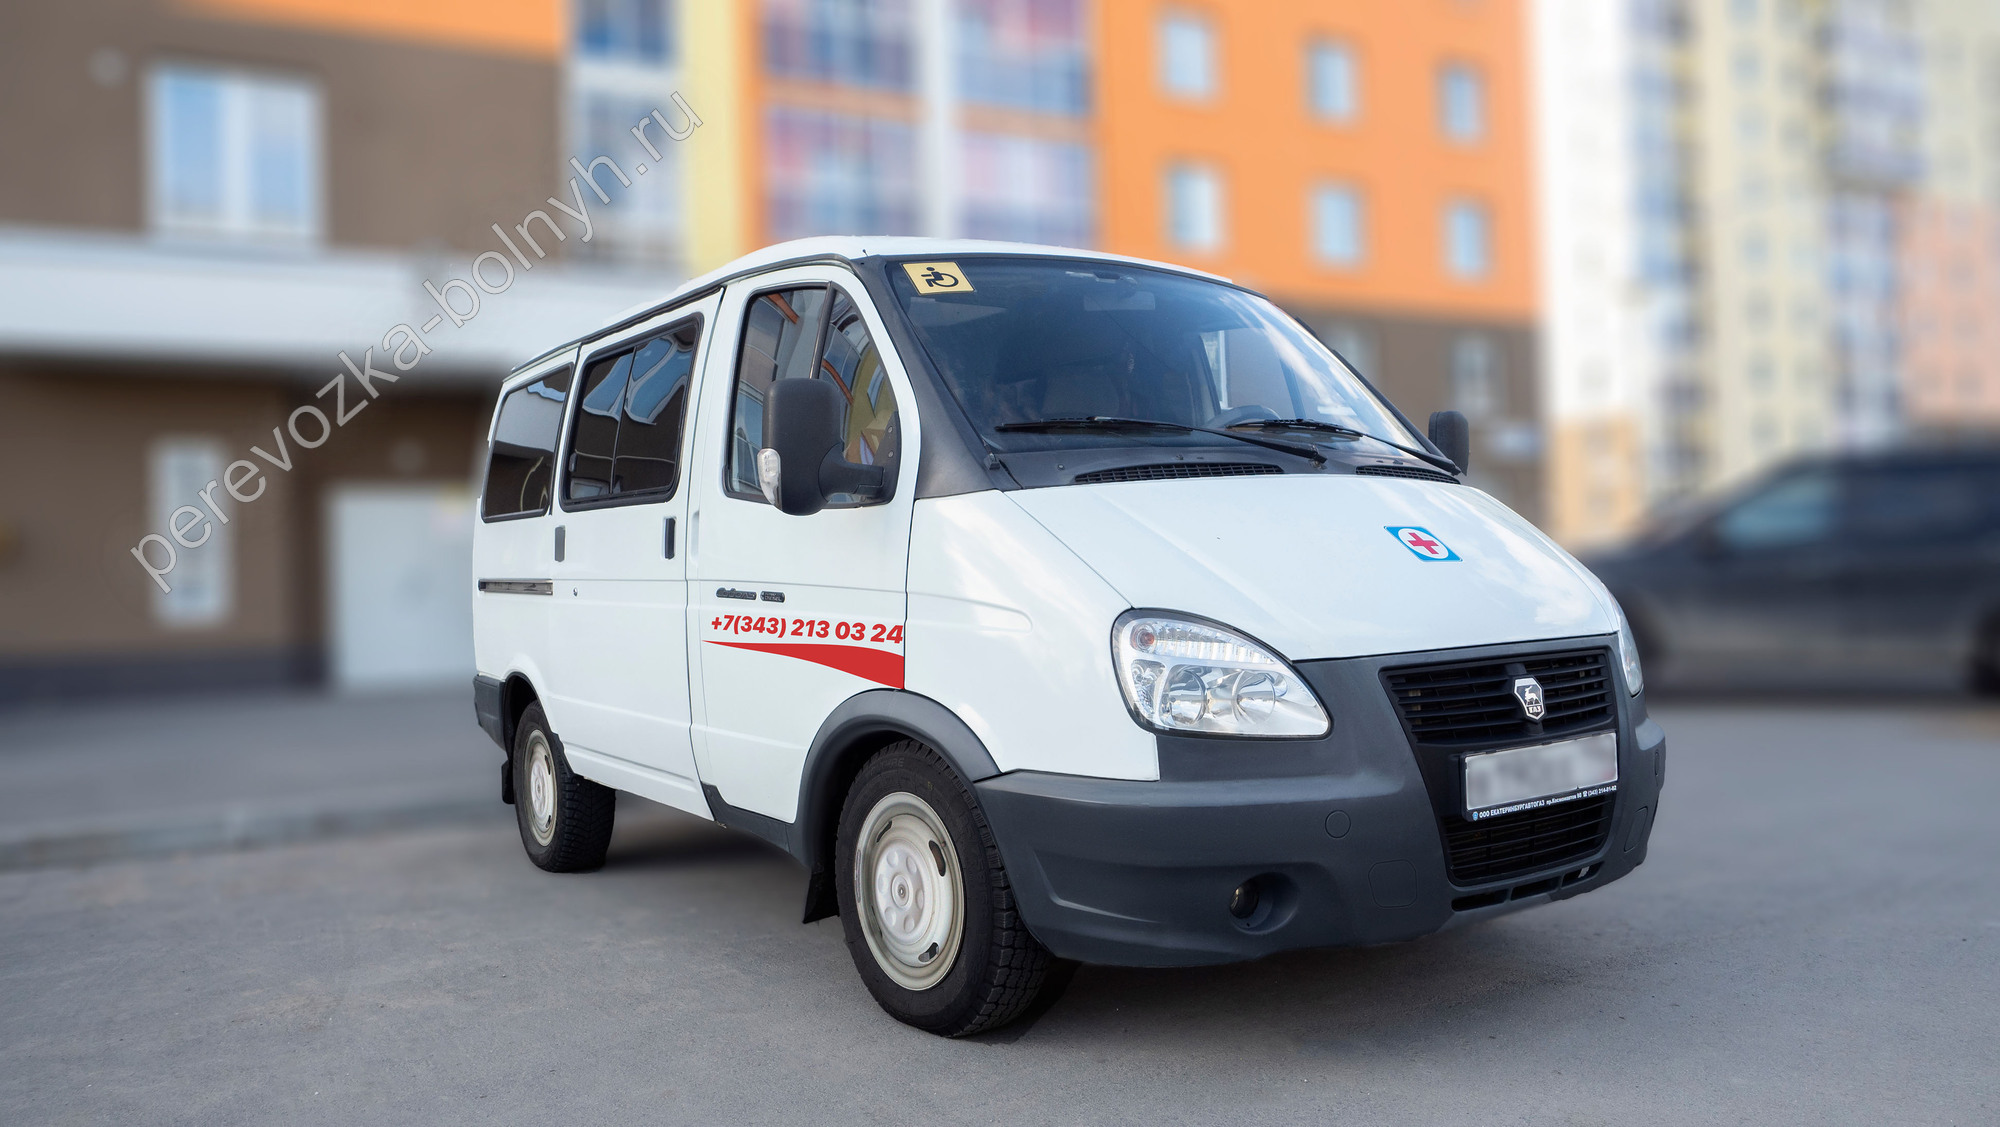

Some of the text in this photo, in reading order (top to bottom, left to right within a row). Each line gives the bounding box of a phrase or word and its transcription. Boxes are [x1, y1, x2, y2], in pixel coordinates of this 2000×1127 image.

[711, 615, 903, 643] +7(343) 213 03 24
